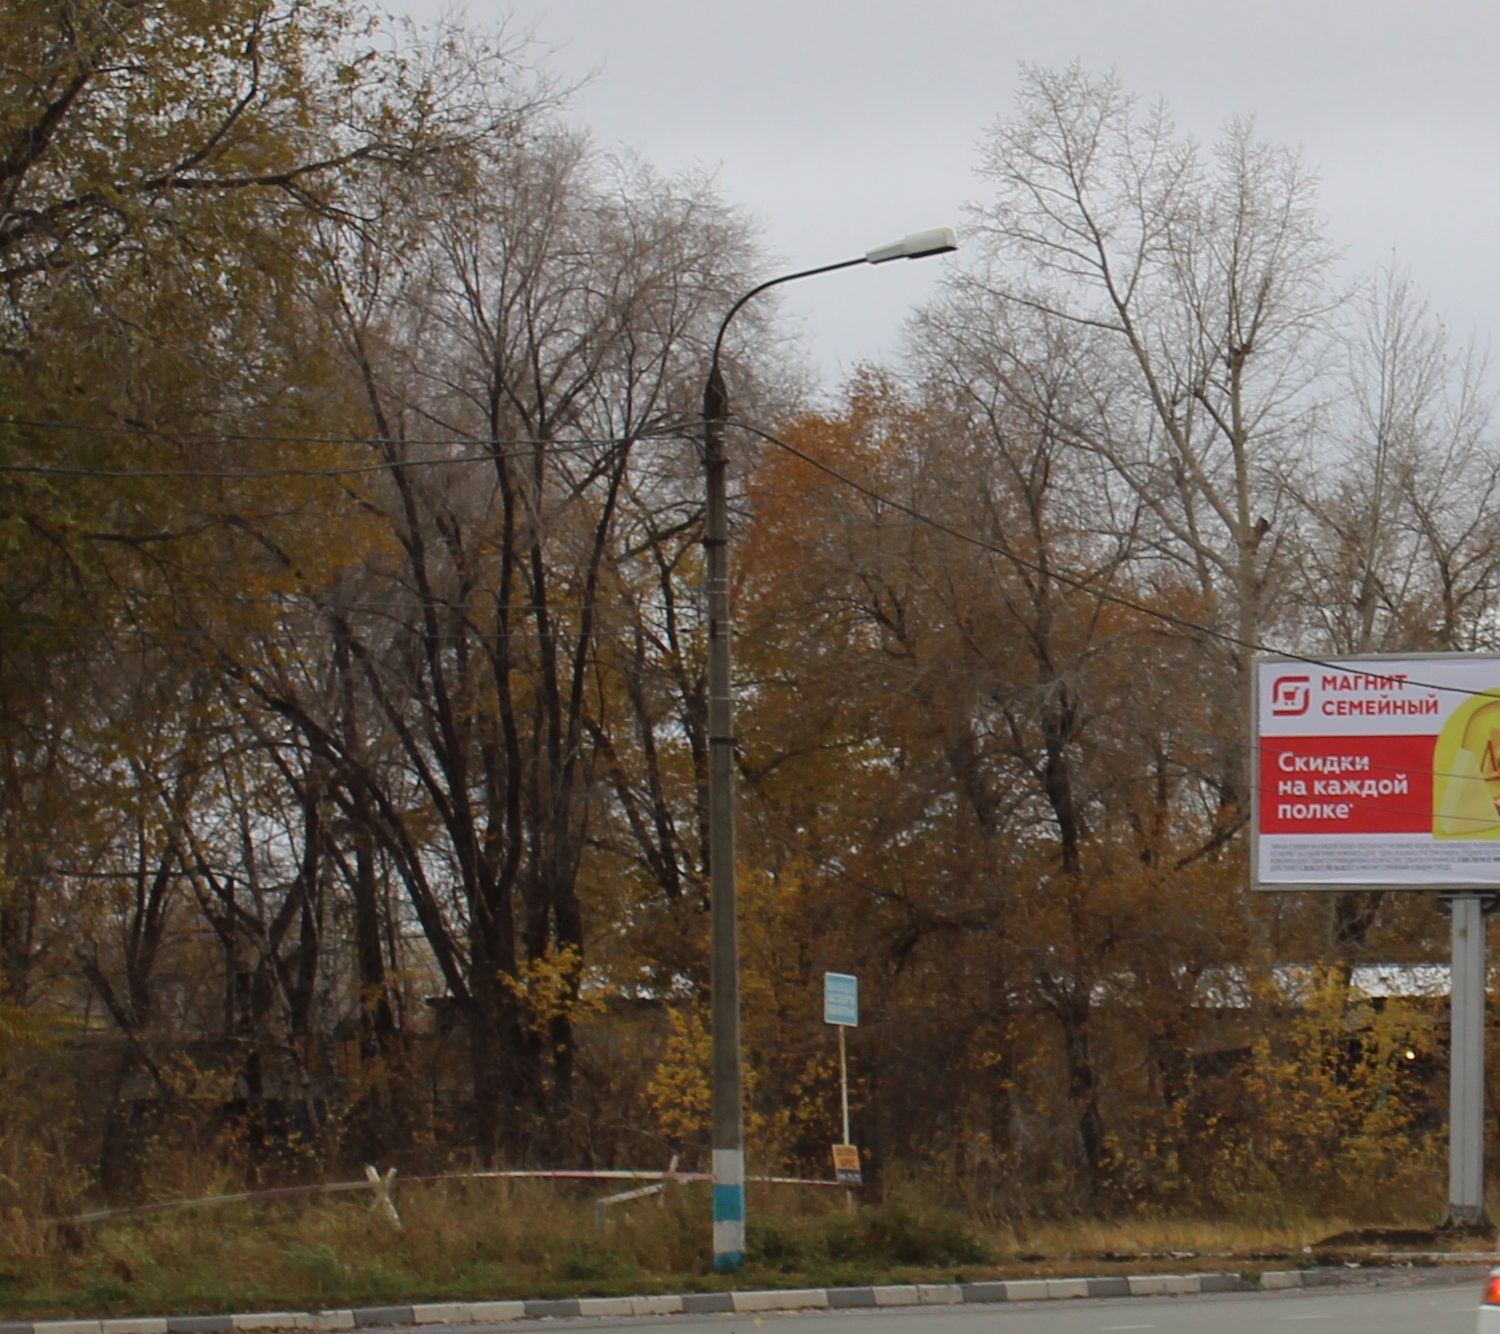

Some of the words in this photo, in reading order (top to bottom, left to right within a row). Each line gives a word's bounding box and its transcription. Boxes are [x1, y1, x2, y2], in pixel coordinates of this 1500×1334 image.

[1322, 674, 1407, 691] МАГНИТ
[1322, 694, 1439, 716] СЕМЕЙНЫЙ
[1278, 751, 1370, 774] Скидки
[1278, 779, 1308, 796] на
[1314, 773, 1408, 798] каждой
